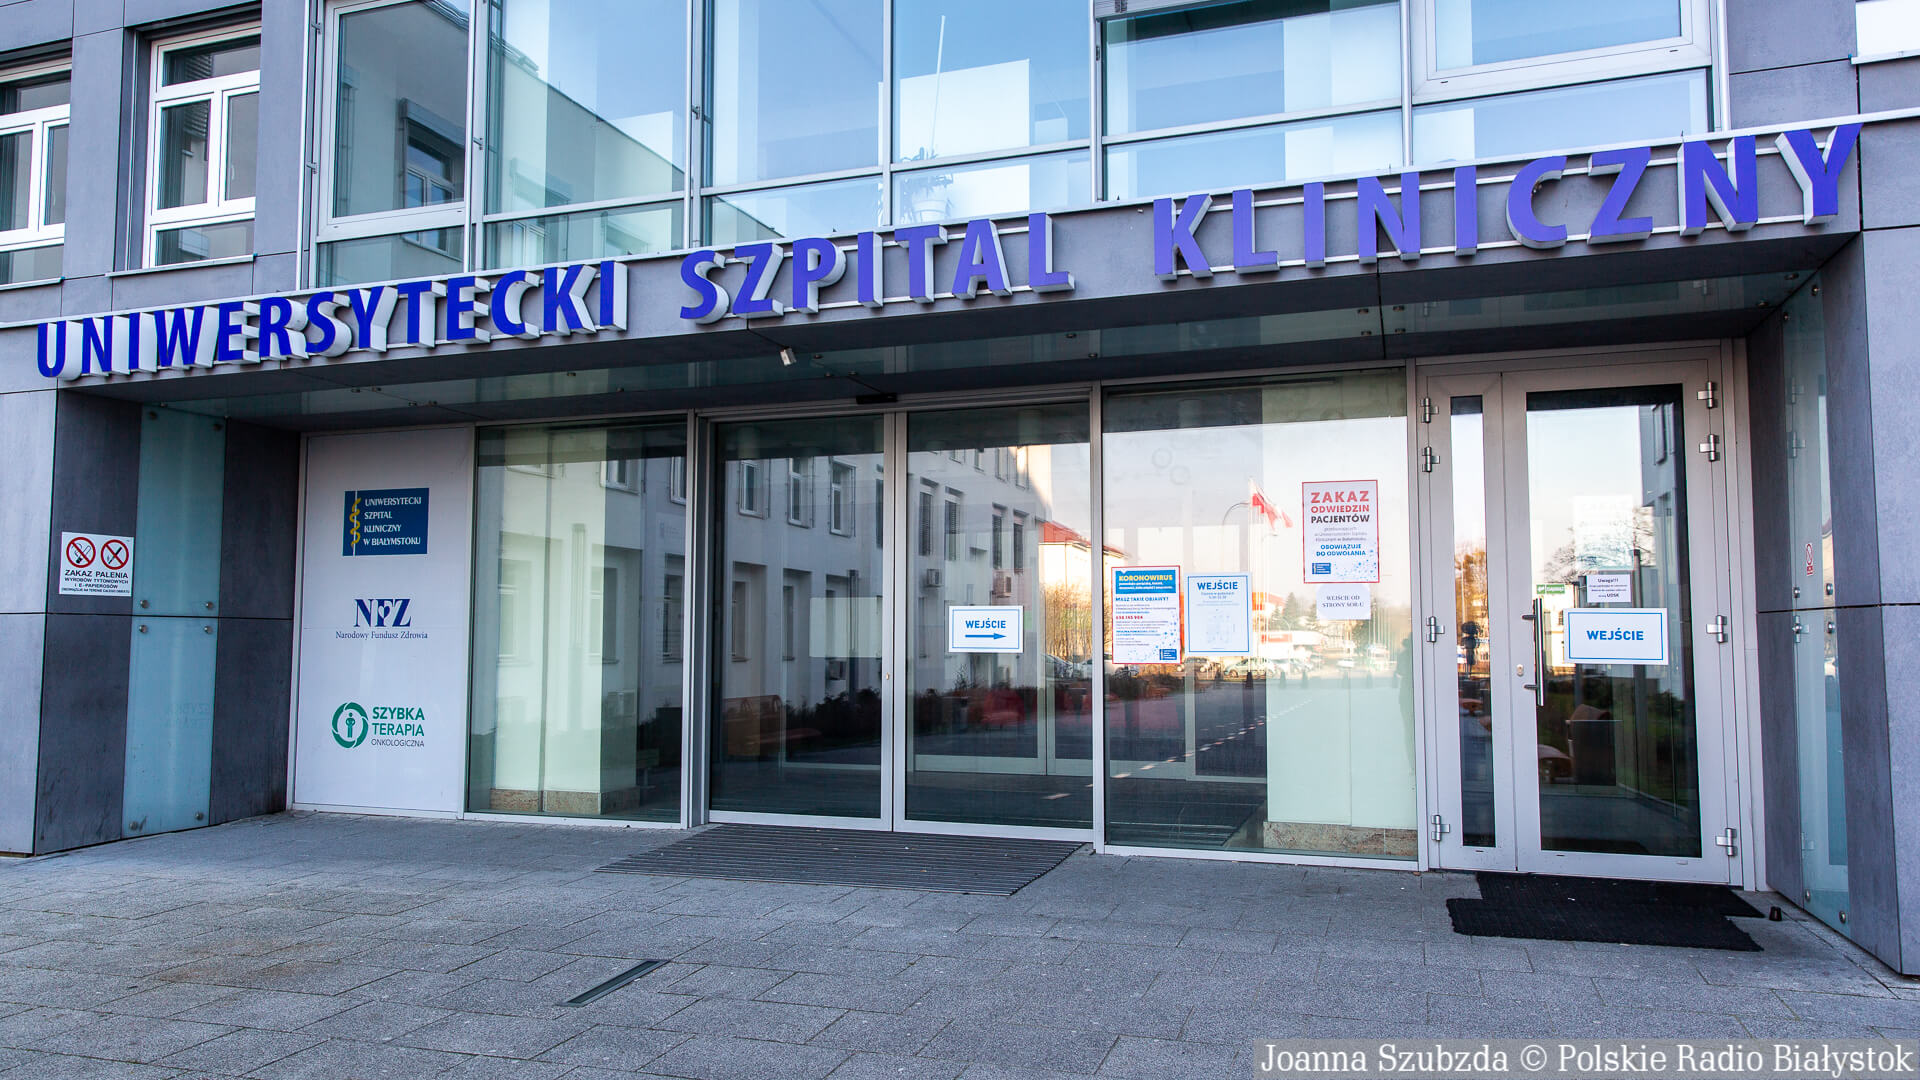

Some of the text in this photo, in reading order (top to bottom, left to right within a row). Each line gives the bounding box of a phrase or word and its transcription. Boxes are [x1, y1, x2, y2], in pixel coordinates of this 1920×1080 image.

[37, 123, 1863, 381] UNIWERSYTECKI SZPITAL KLINICZNY
[364, 496, 422, 507] UNIWERSYTECKI
[1310, 489, 1370, 504] ZAKAZ
[1310, 504, 1370, 514] ODWIEDZIN
[363, 510, 393, 520] SZPITAL
[1310, 513, 1370, 524] PACJENTÓW
[363, 524, 402, 534] KLINICZNY
[363, 537, 421, 546] W BIAŁYMSTOKU
[64, 569, 129, 579] ZAKAZ PALENIA
[1196, 579, 1239, 591] WEJŚCIE
[353, 598, 412, 627] NFZ
[965, 617, 1007, 629] WEJŚCIE
[335, 630, 428, 640] Narodowy Fundusz Zdrowia
[1586, 628, 1644, 641] WEJŚCIE
[372, 707, 425, 721] SZYBKA
[372, 722, 425, 737] TERAPIA
[371, 738, 425, 748] ONKOLOGICZNA
